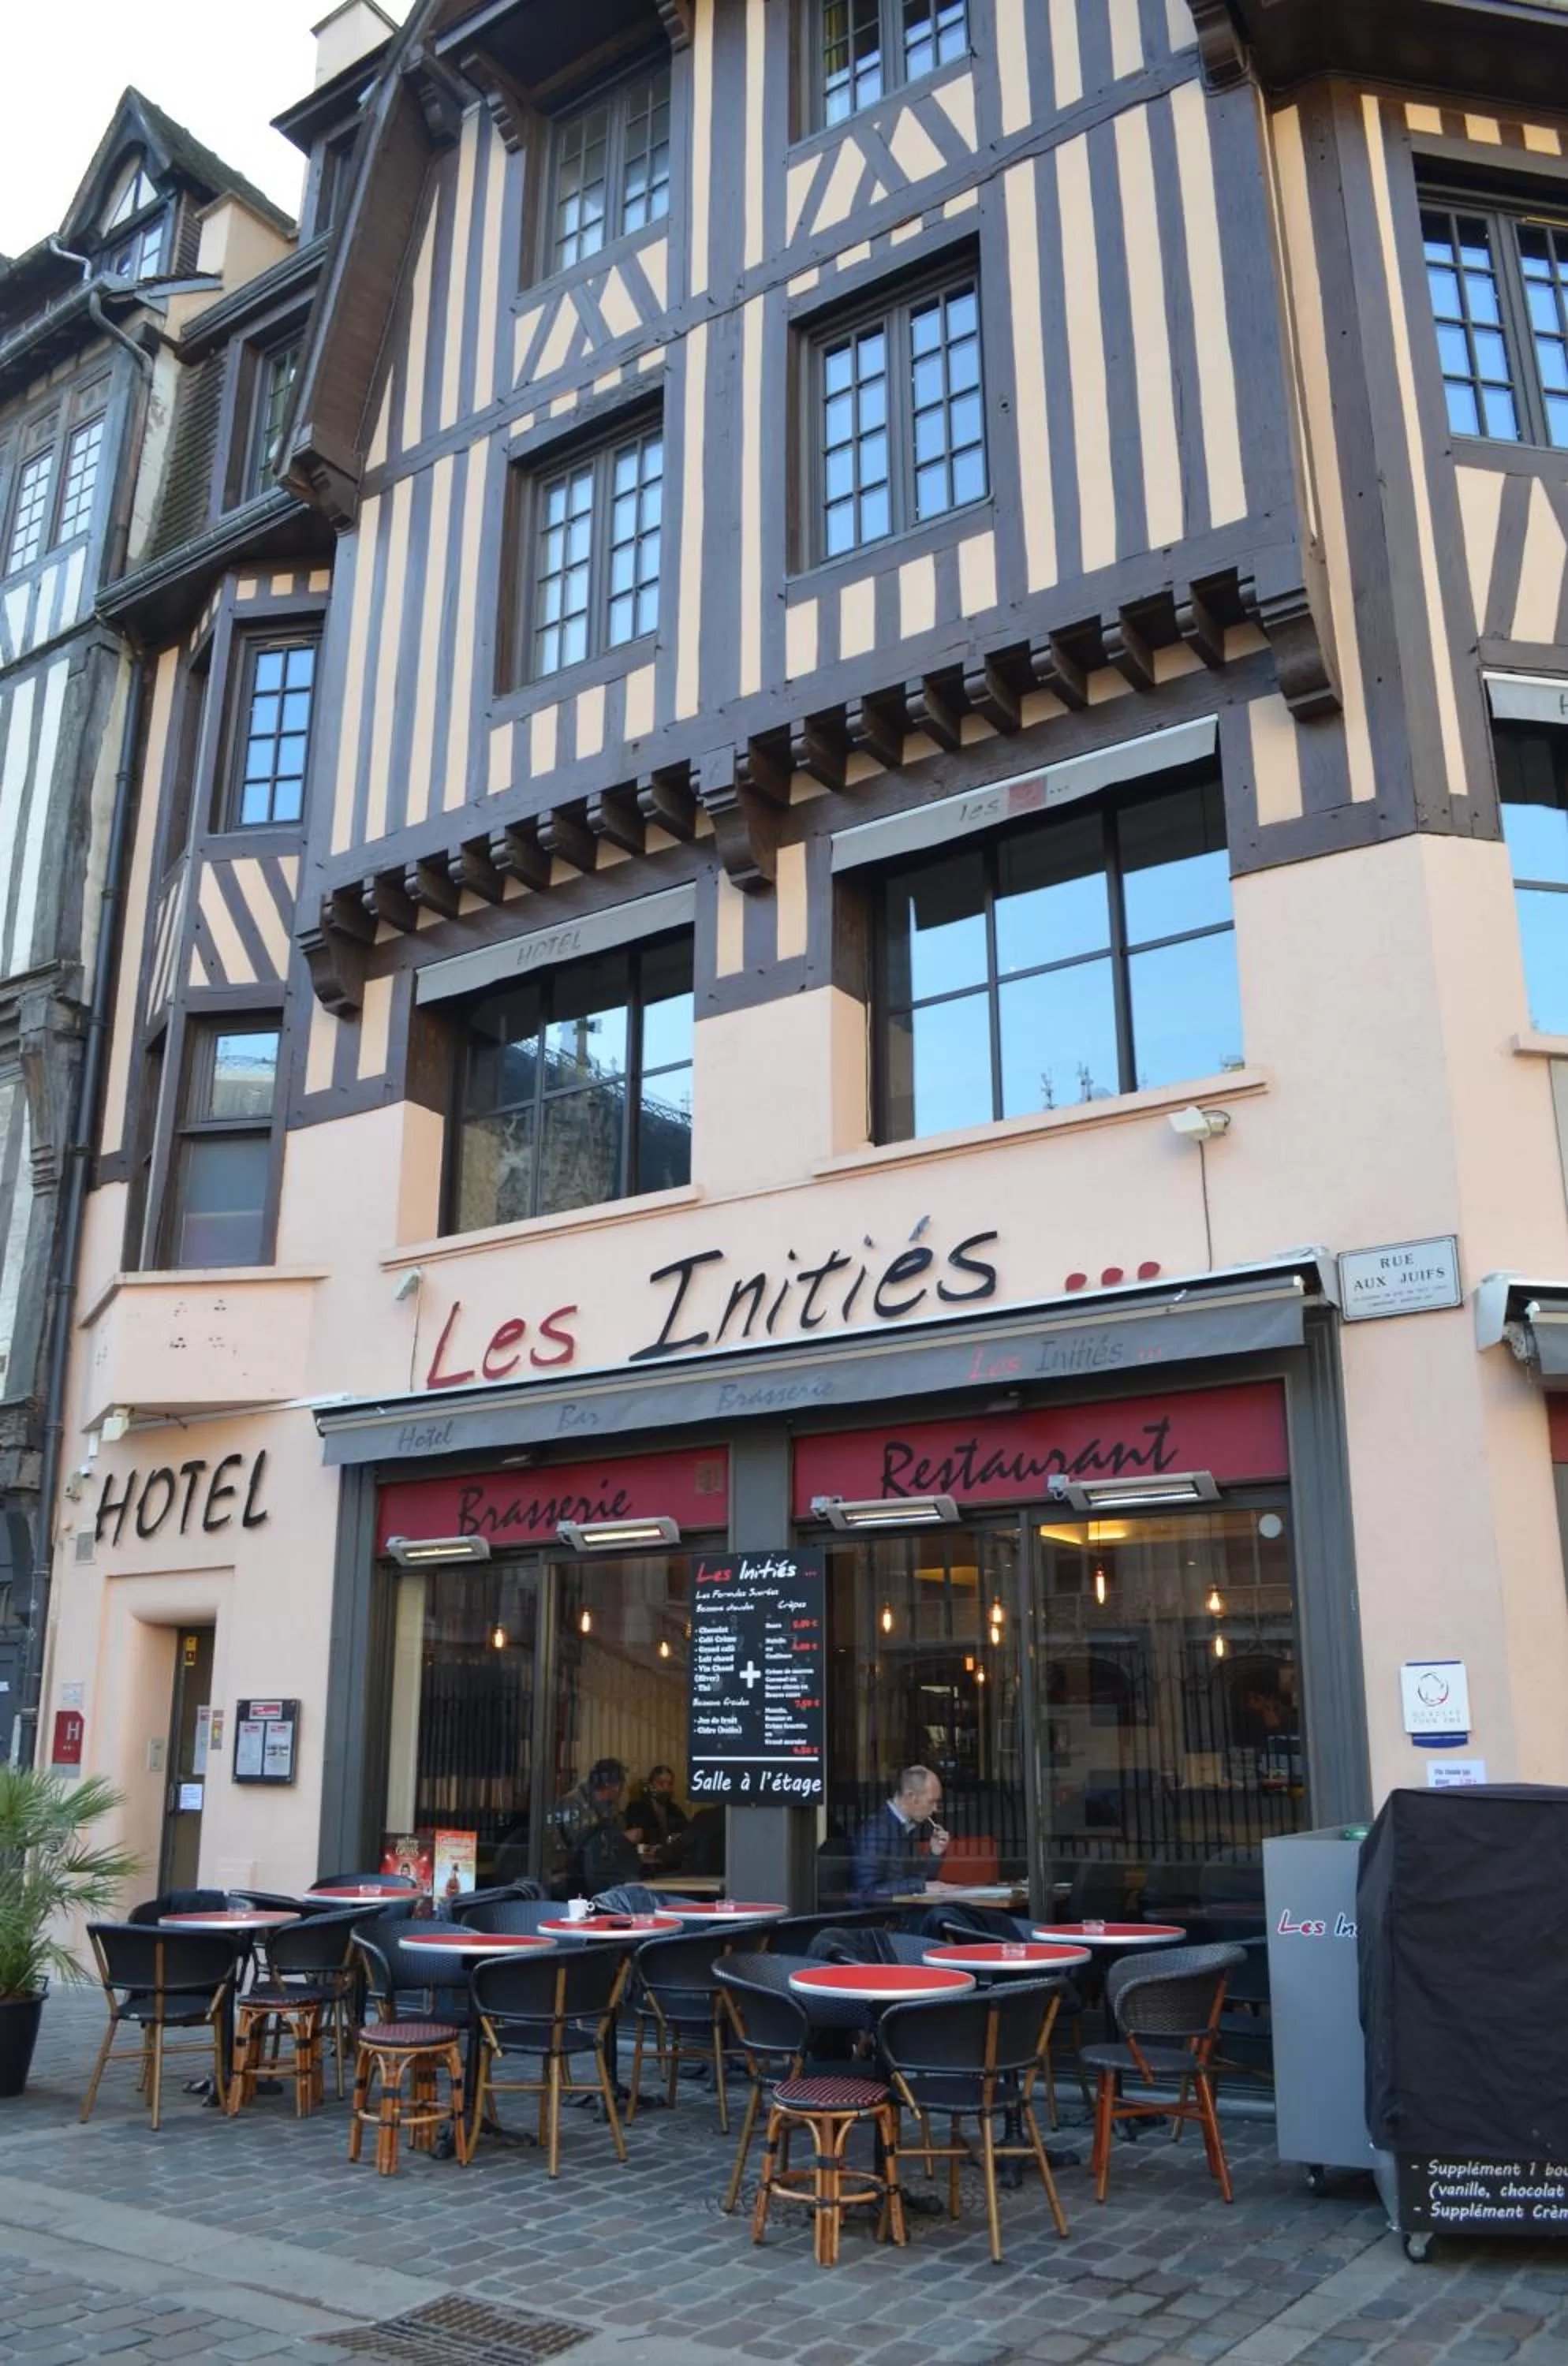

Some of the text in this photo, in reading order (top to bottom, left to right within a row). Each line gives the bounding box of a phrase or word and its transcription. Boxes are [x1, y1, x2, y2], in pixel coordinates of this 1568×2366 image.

[517, 932, 581, 966] HOTEL
[1380, 1252, 1414, 1269] RUE
[1353, 1268, 1446, 1292] AUX JUIFS
[427, 1301, 578, 1390] Les
[629, 1215, 999, 1362] Initiés
[715, 1378, 836, 1414] Brasserie
[968, 1344, 1021, 1380] Les
[1035, 1336, 1124, 1373] Initiés
[879, 1416, 1179, 1499] Restaurant
[95, 1449, 267, 1547] HOTEL
[457, 1480, 632, 1537] Brasserie
[696, 1562, 732, 1584] Les
[66, 1721, 80, 1741] H
[692, 1770, 821, 1797] Salle à l'étage
[1278, 1909, 1326, 1935] Les
[1427, 2159, 1521, 2178] Supplément
[1429, 2181, 1565, 2199] (vanille, chocolat
[1430, 2201, 1524, 2221] Supplément
